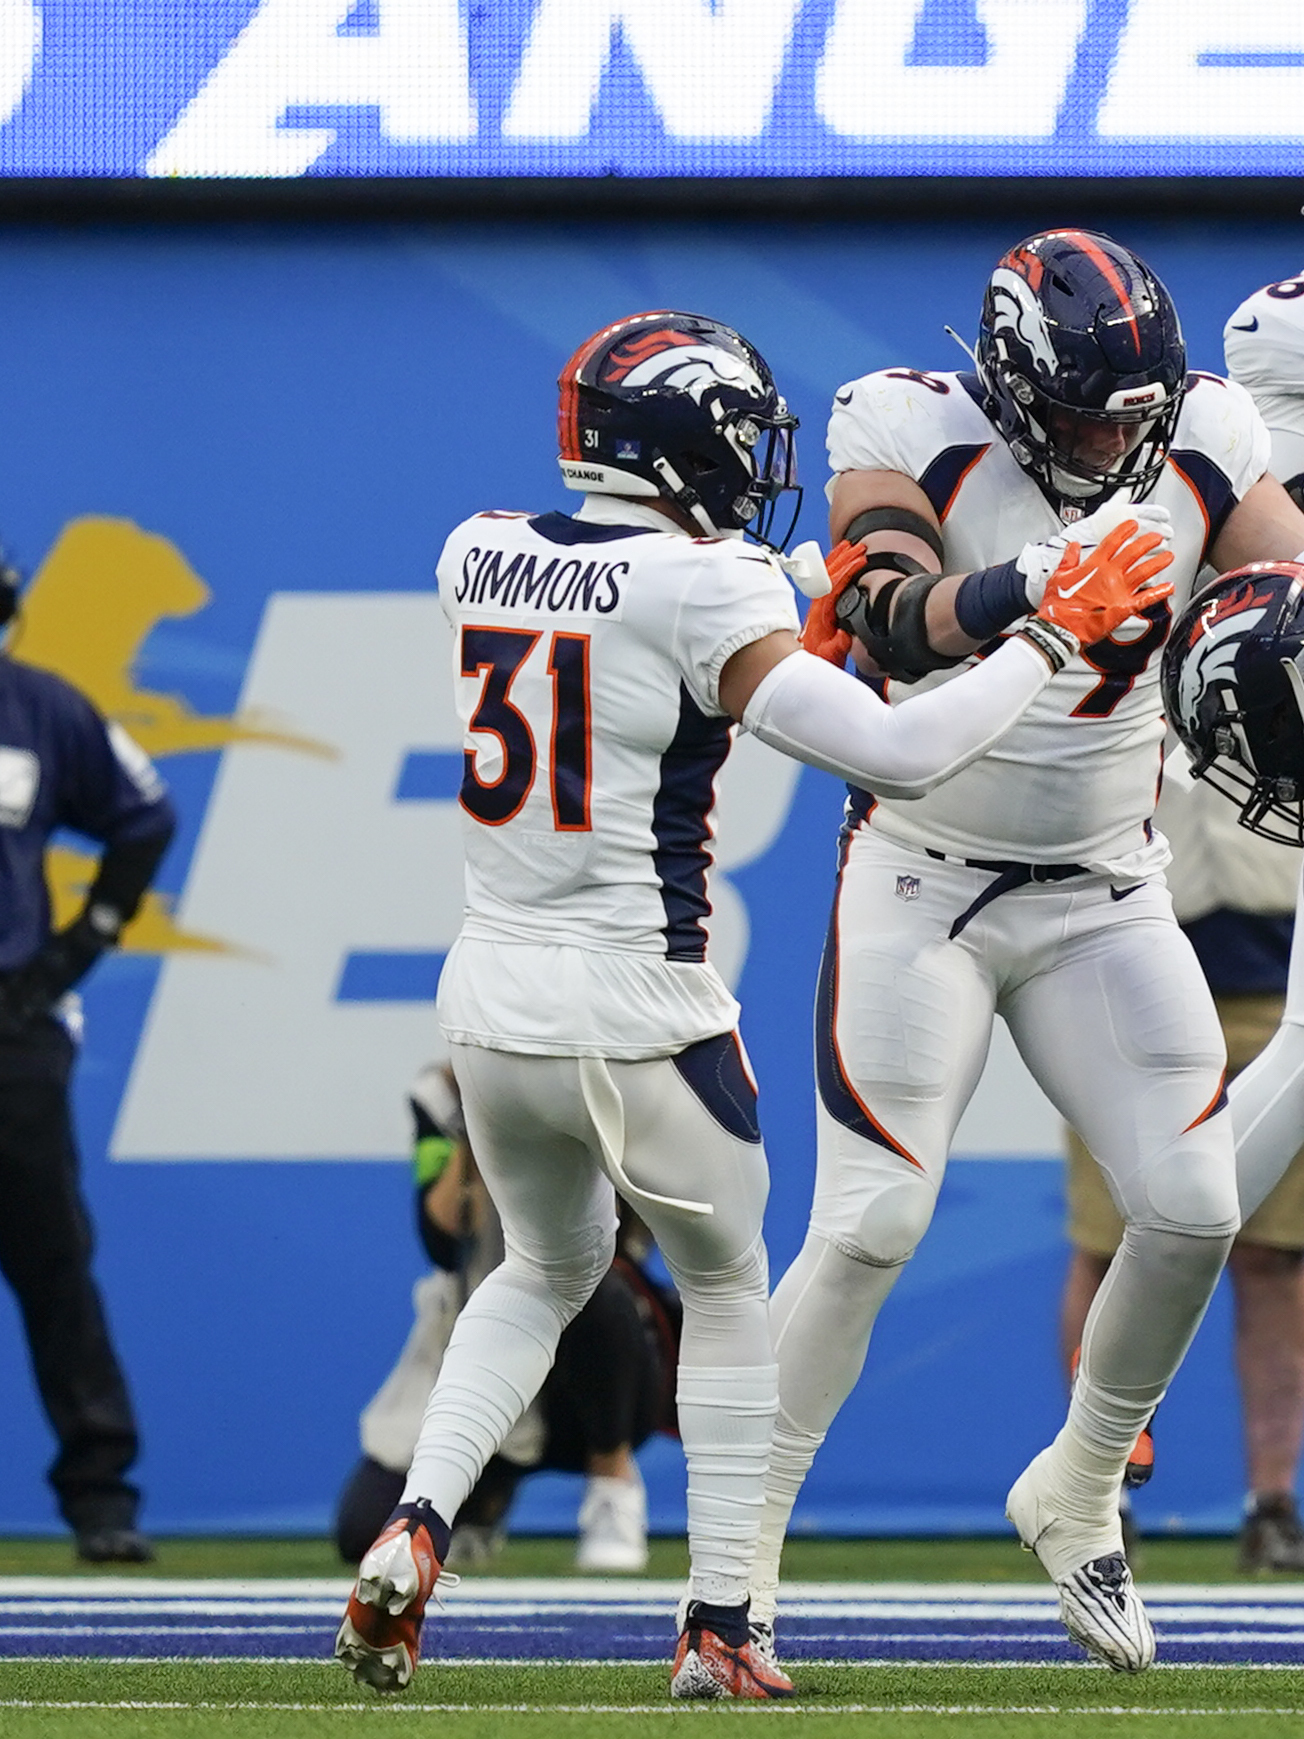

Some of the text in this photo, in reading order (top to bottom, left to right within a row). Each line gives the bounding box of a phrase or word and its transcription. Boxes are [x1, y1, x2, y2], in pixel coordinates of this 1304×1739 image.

[584, 429, 599, 449] 31
[566, 468, 604, 483] CHANGE
[455, 546, 630, 614] SIMMONS
[458, 623, 593, 832] 31
